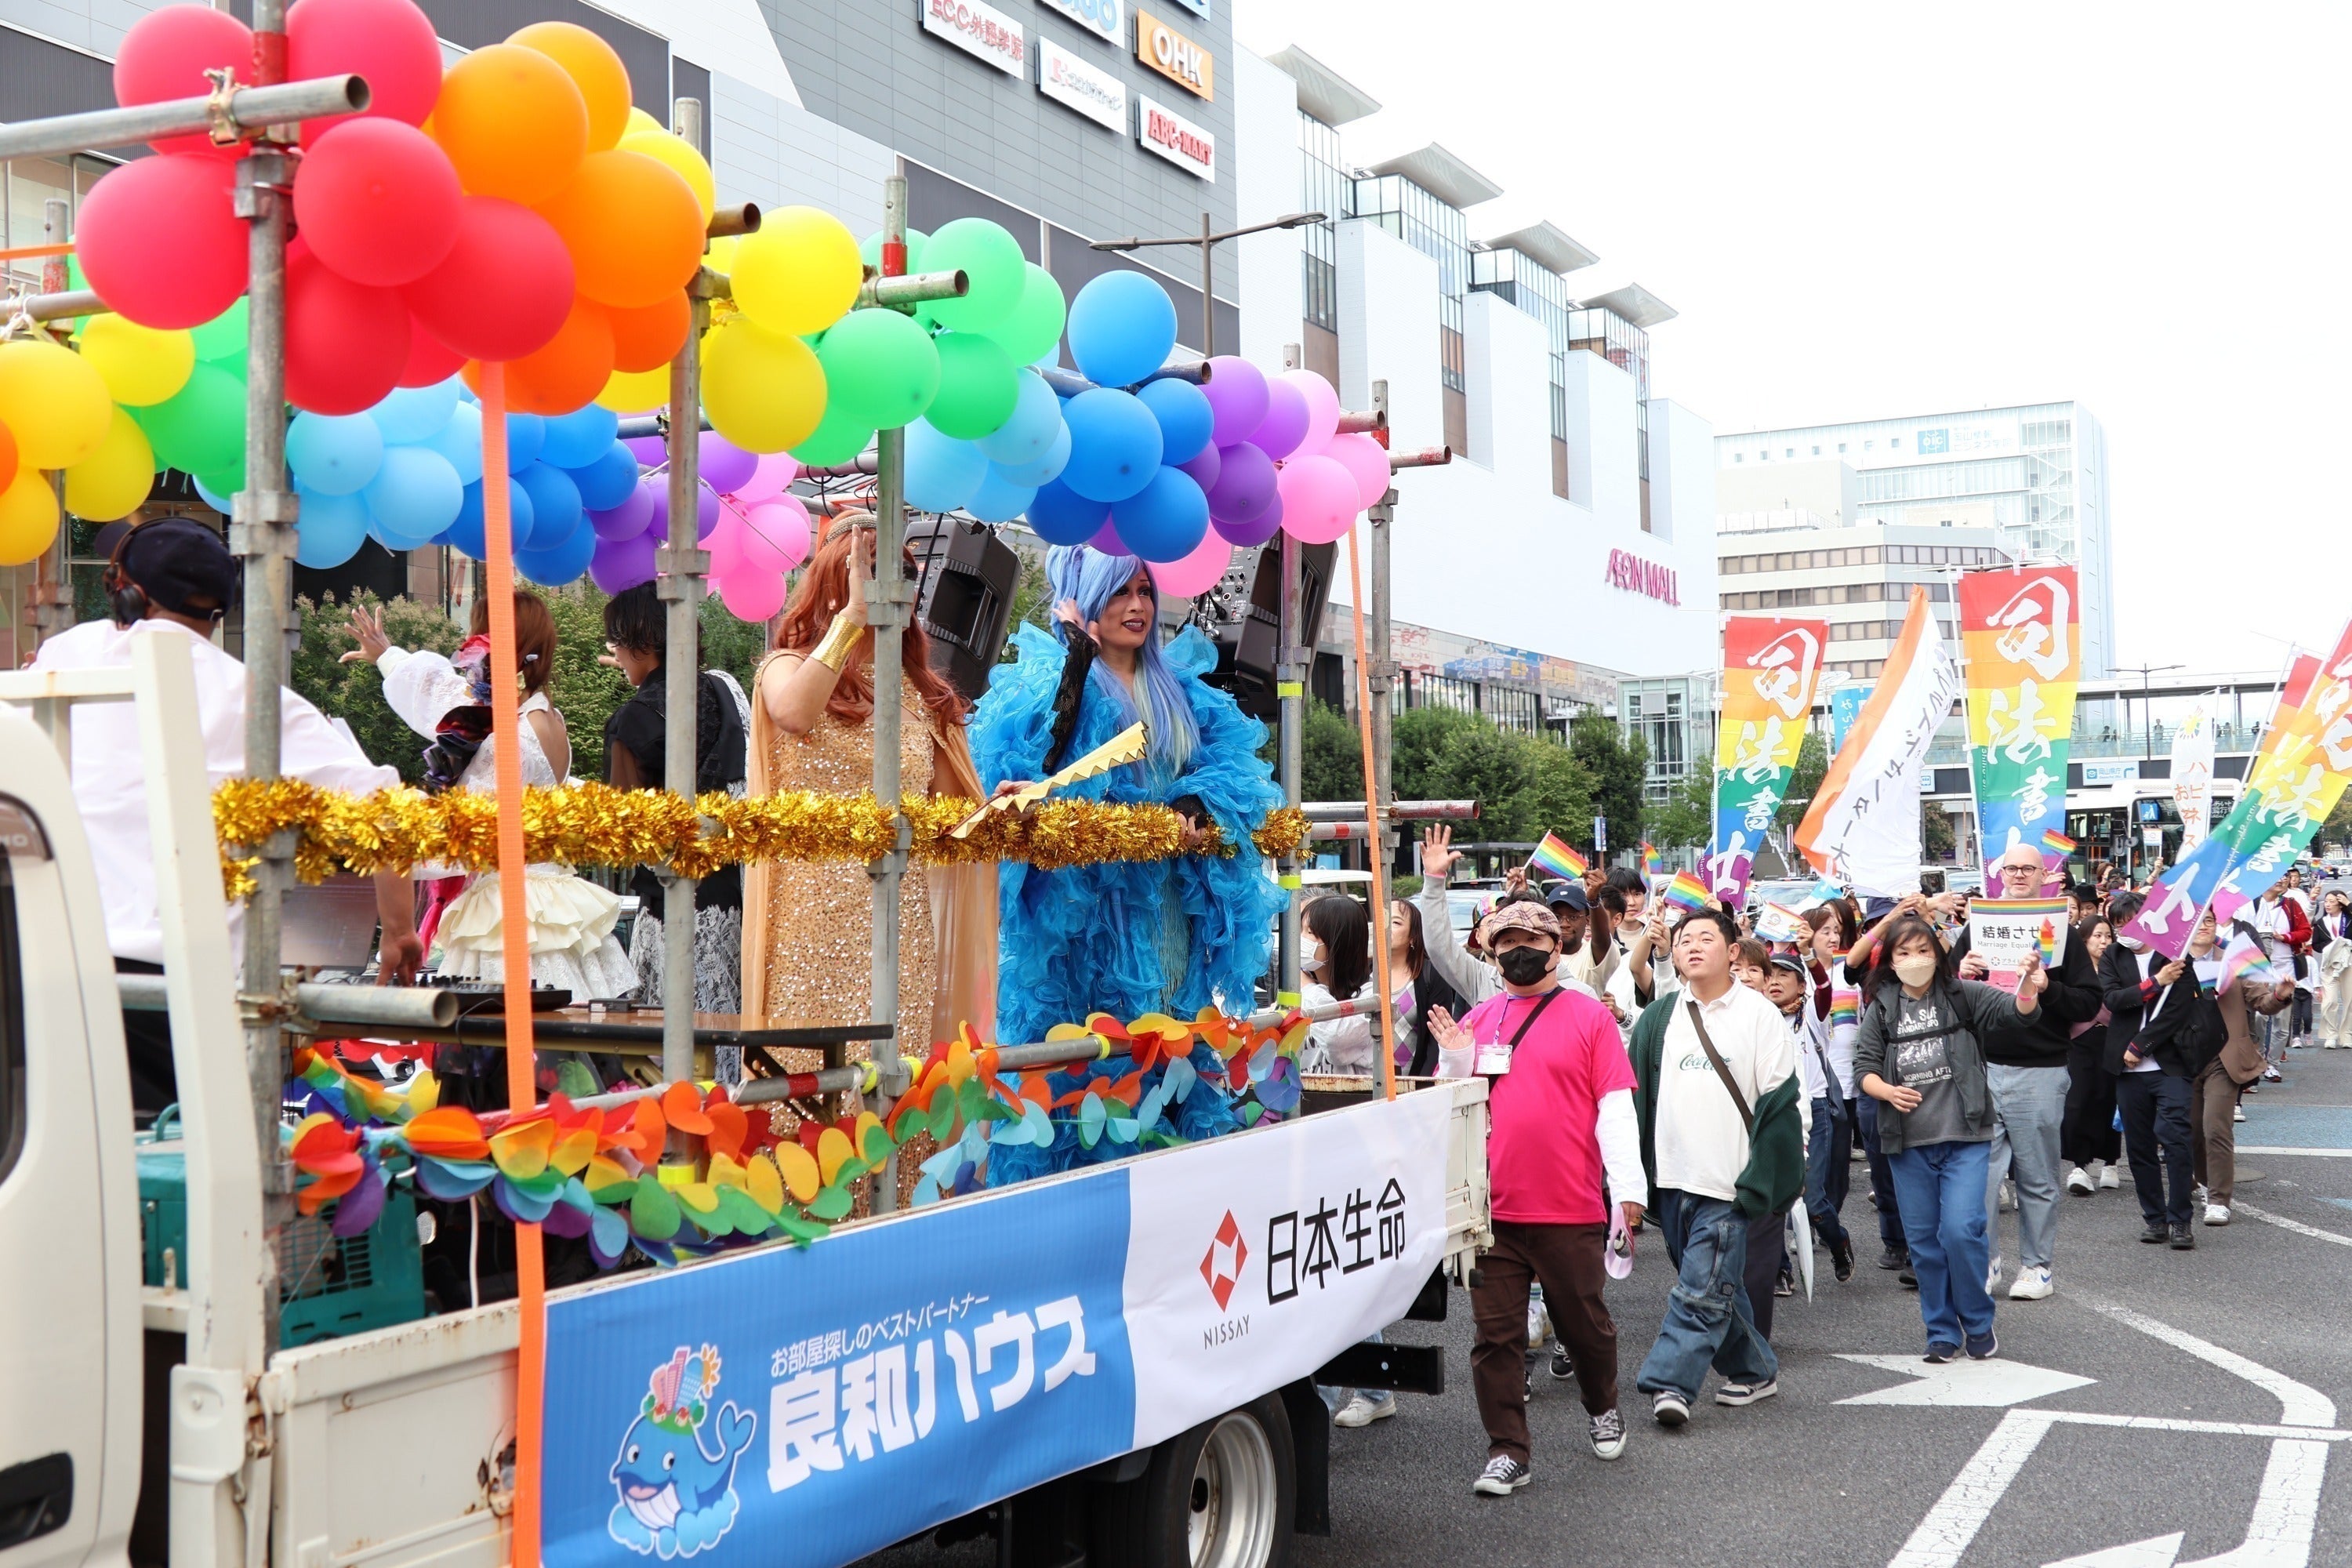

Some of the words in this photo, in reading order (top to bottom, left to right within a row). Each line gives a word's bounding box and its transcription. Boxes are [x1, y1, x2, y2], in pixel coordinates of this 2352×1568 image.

[1152, 27, 1203, 88] OHK
[1148, 109, 1212, 165] ABC-MART
[1645, 560, 1682, 606] MALL
[1982, 925, 2055, 939] 結婚させ
[1903, 1070, 1933, 1082] MORNING
[1267, 1178, 1406, 1305] 日本生命
[770, 1292, 989, 1377] お部屋探しのベストパートナー
[1203, 1314, 1250, 1350] NISSAY
[767, 1295, 1096, 1493] 良和ハウス
